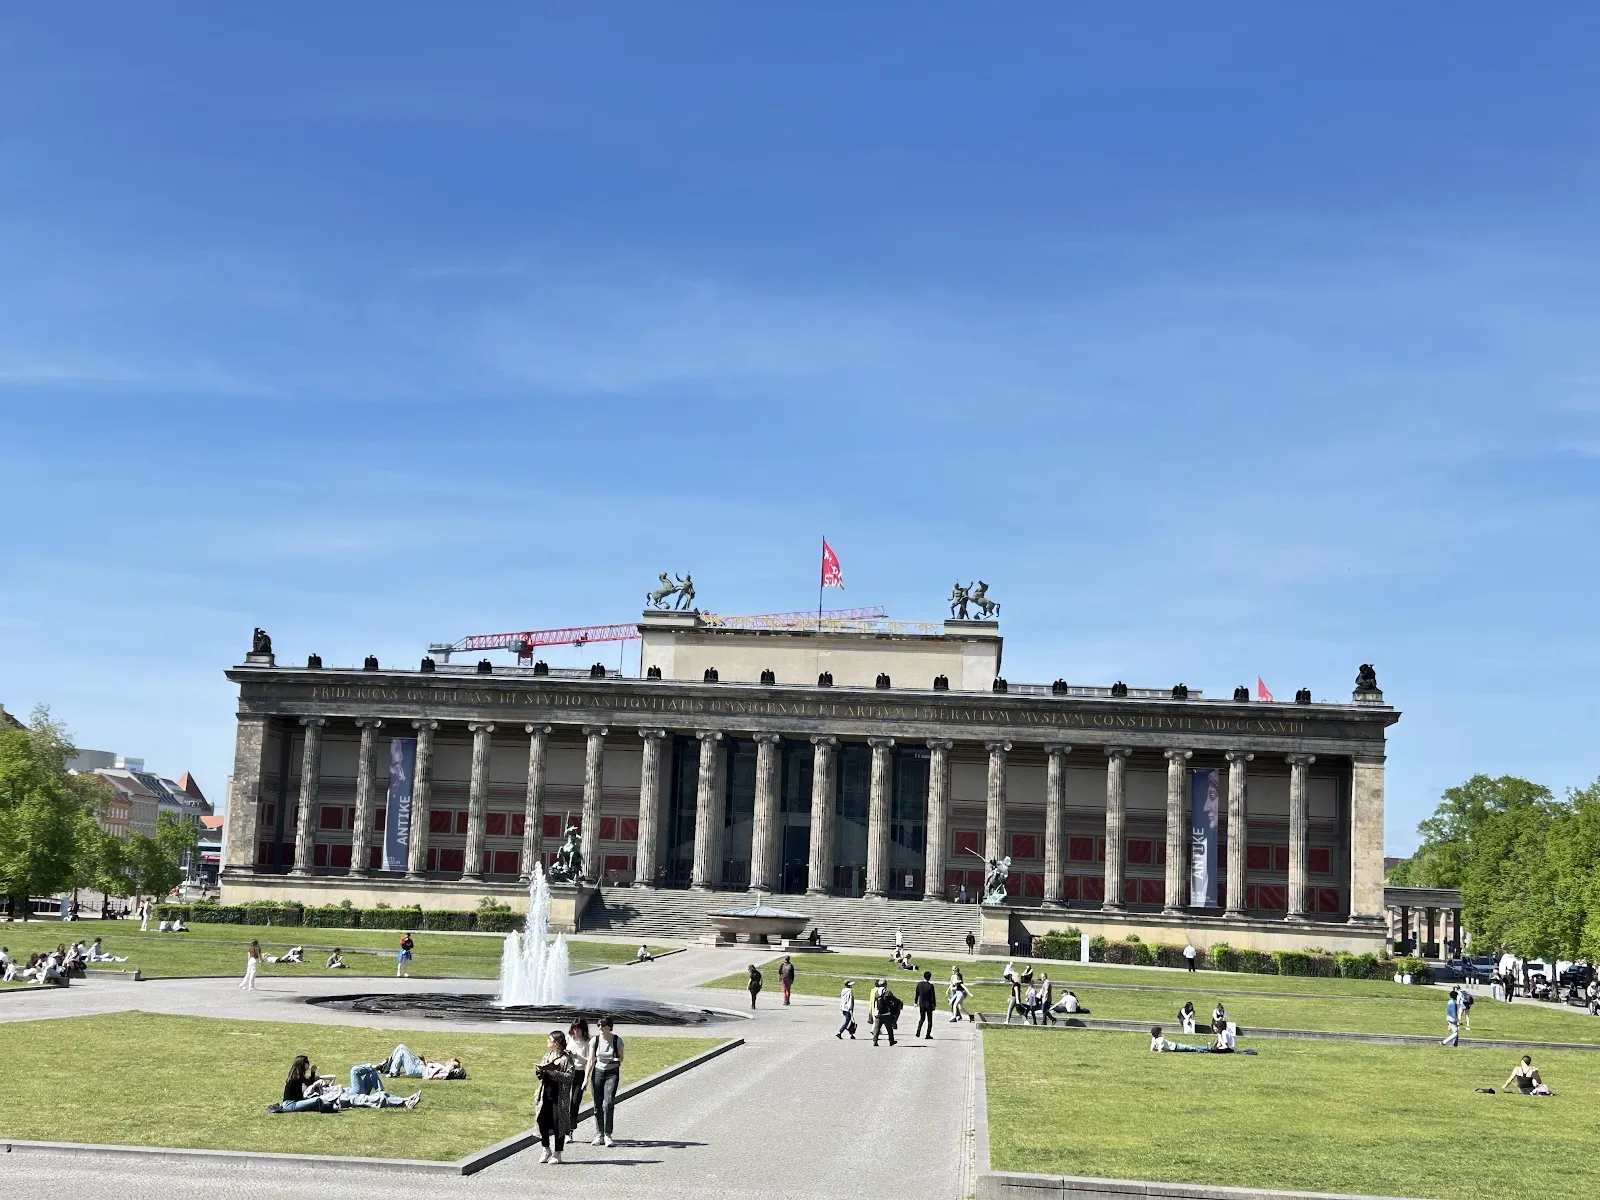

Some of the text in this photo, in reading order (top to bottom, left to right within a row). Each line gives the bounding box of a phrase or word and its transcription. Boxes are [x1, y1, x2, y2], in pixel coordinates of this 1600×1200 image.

[312, 686, 398, 700] FRIDERICVS
[500, 693, 516, 704] III
[524, 693, 581, 705] STVDIO
[590, 695, 704, 711] ANTIQVITATIS
[819, 704, 838, 716] ET
[844, 705, 905, 719] ARTIVM
[914, 706, 1010, 722] LIBERALIVM
[1019, 711, 1085, 725] MVSEVM
[1093, 714, 1192, 729] CONSTITVIT
[396, 795, 411, 846] ANTIKE
[1192, 827, 1205, 880] ANTIKE
